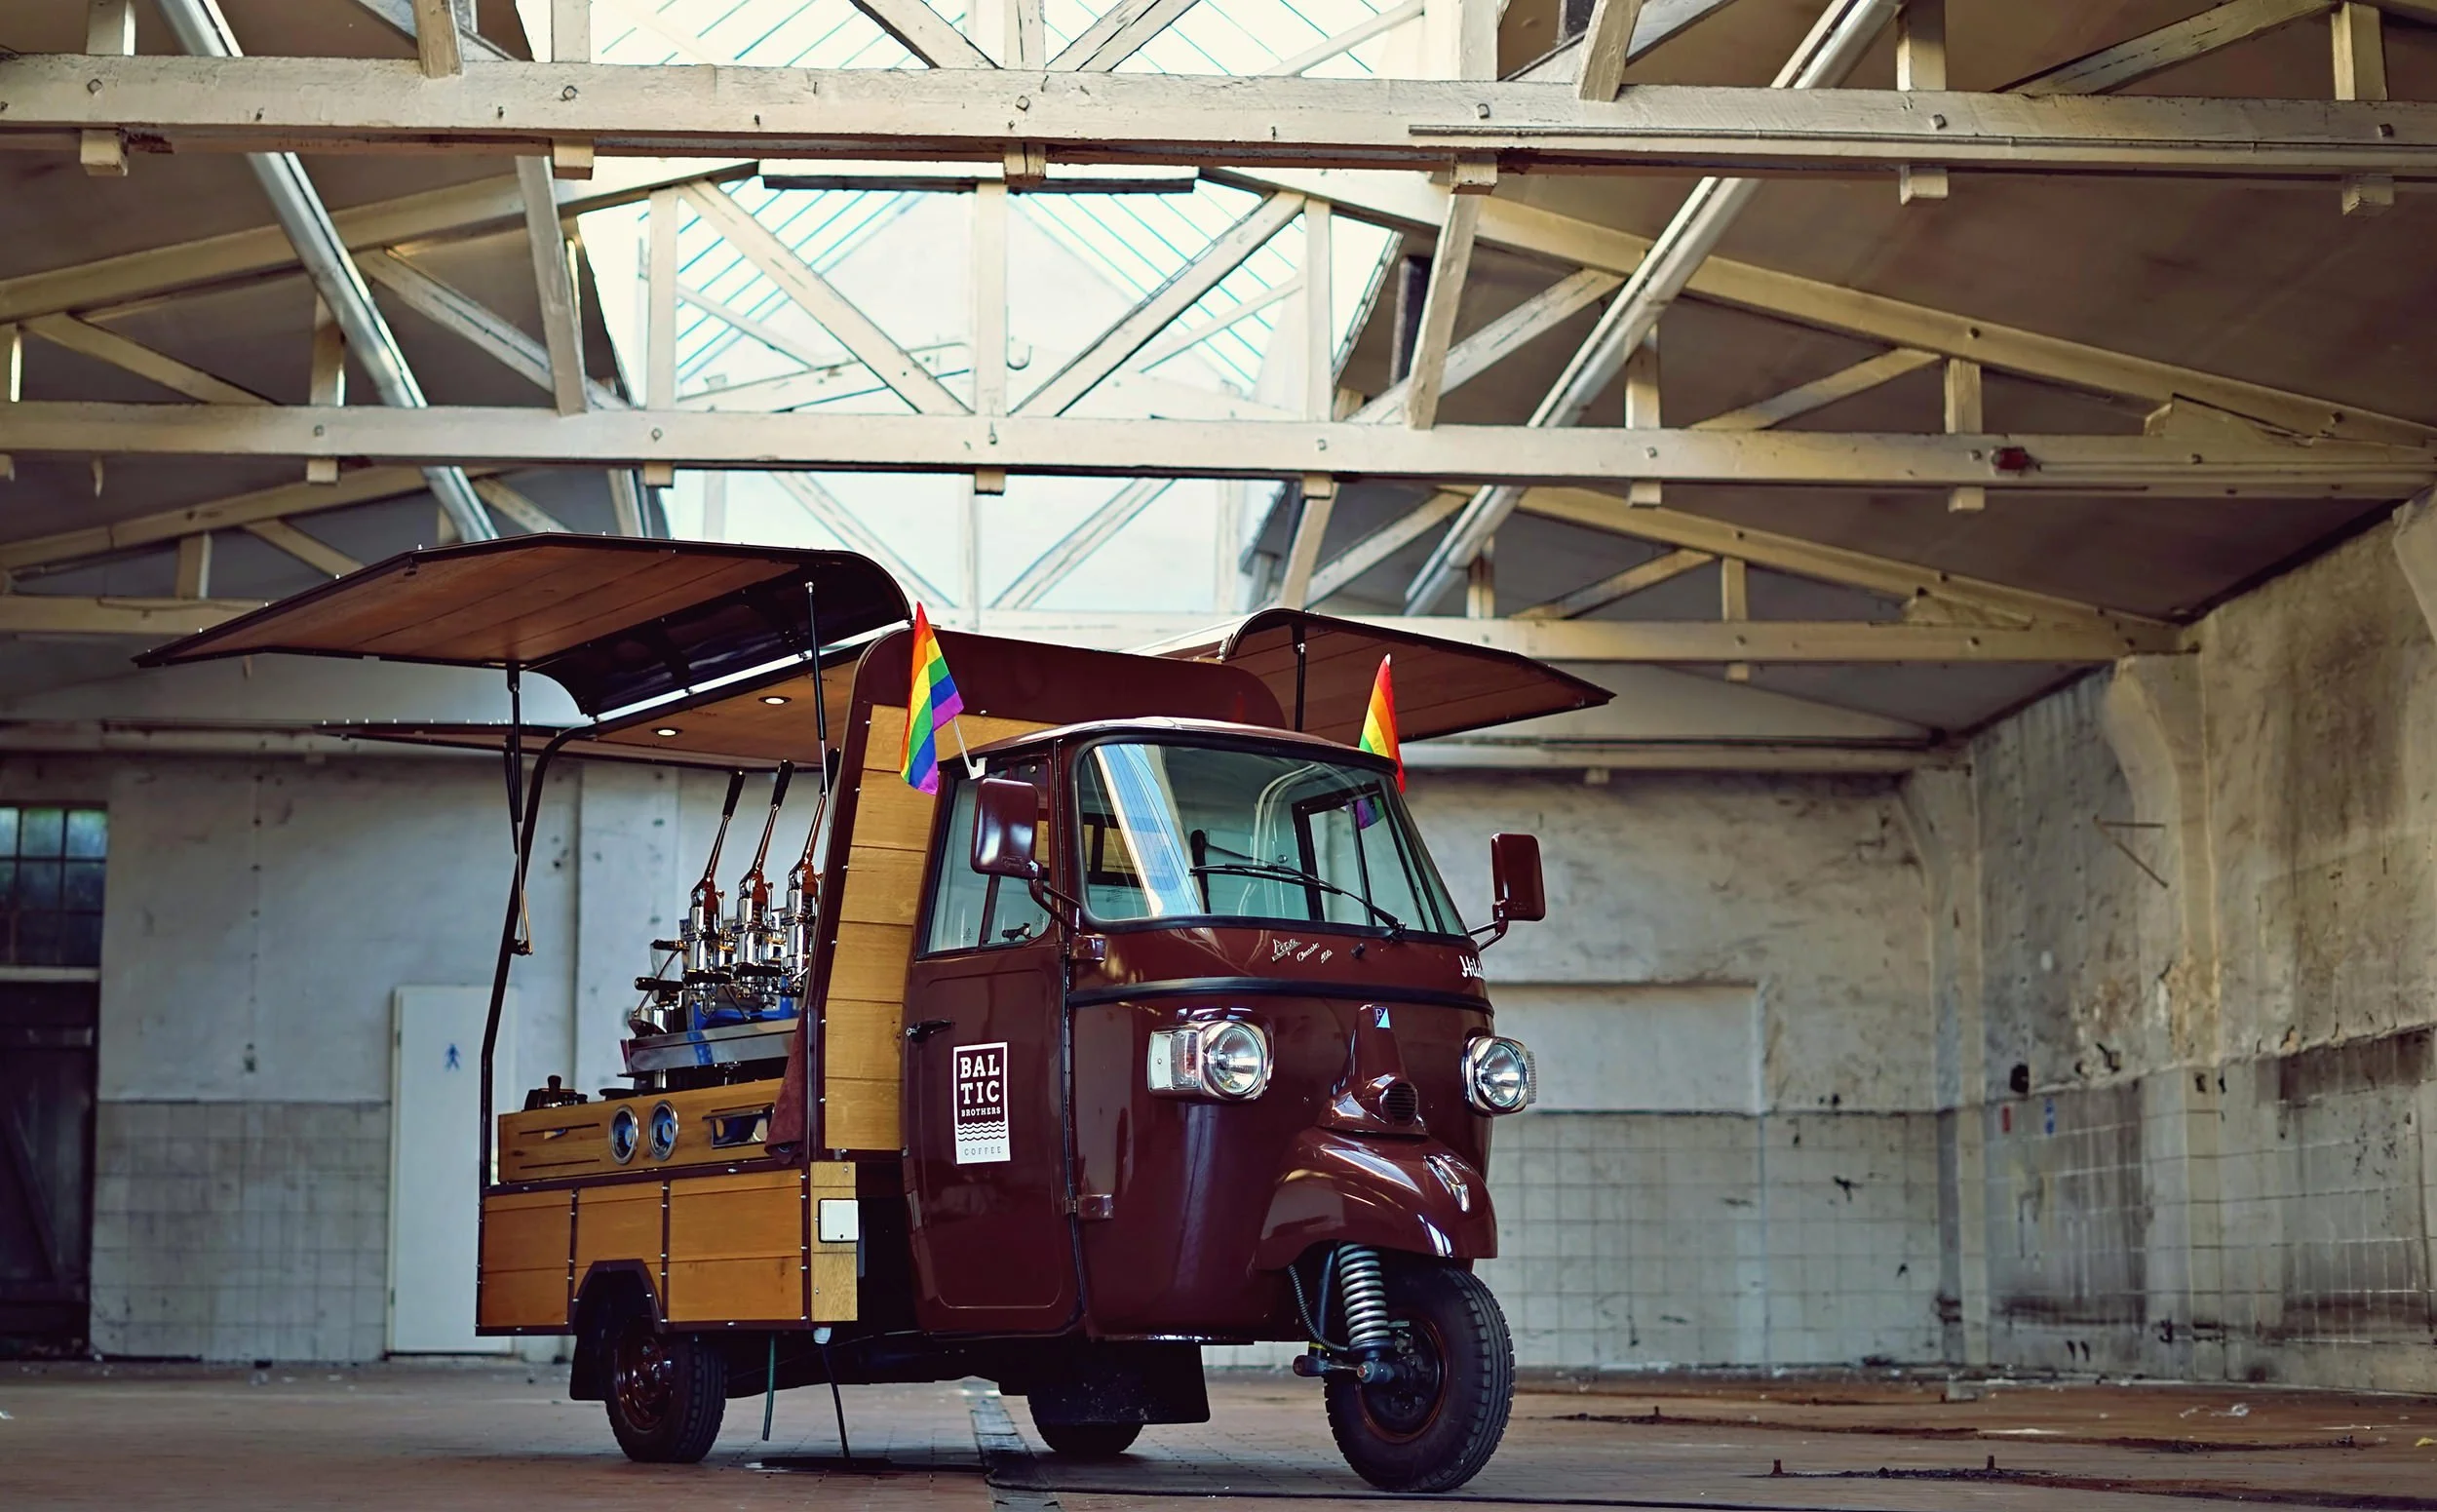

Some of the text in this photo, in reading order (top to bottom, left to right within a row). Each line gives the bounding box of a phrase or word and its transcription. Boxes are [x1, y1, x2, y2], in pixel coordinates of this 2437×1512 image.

[960, 1054, 1000, 1078] BAL
[960, 1080, 1000, 1105] TIC
[961, 1106, 1001, 1117] BROTHERS
[964, 1146, 1001, 1156] COFFEE
